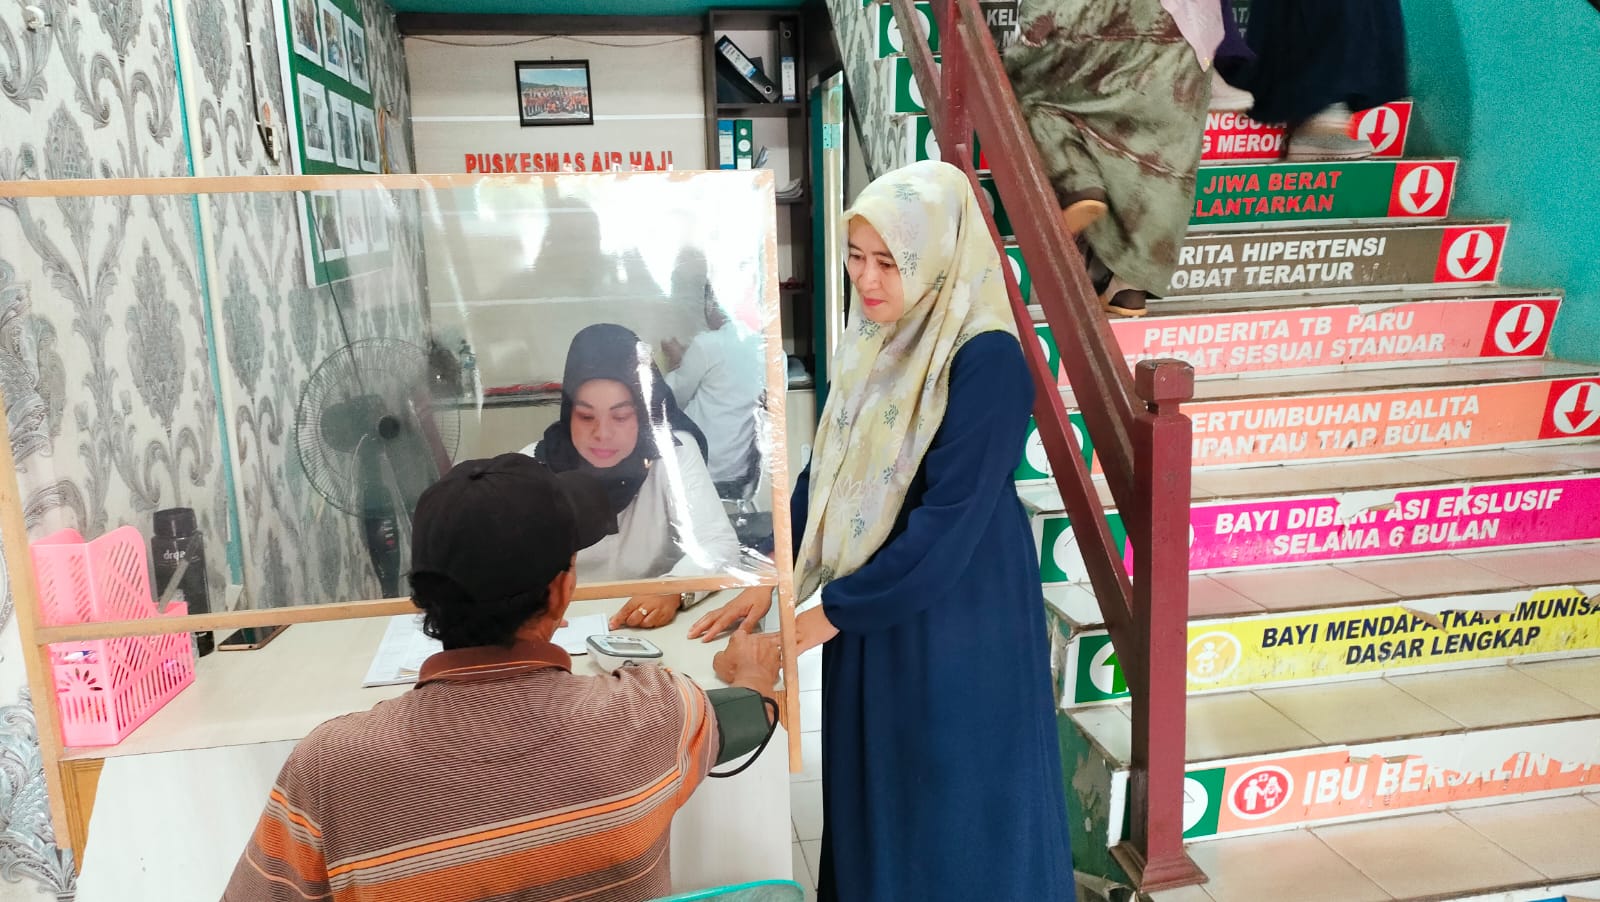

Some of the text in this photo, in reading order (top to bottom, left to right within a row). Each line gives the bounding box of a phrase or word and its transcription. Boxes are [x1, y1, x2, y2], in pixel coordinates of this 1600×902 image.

[1205, 112, 1287, 130] NGG
[464, 151, 673, 174] PUSKESMAS AIR HAJI
[1203, 171, 1342, 194] JIWA BERAT
[1192, 194, 1334, 217] LANTARKAN
[1178, 237, 1386, 266] RITA HIPERTENSI
[1166, 262, 1354, 290] OBAT TERATUR
[1144, 311, 1414, 348] PENDERITA TB PARU
[1229, 339, 1324, 366] SESUAI
[1330, 333, 1445, 359] STANDAR
[1191, 395, 1480, 433] ERTUMBUHAN BALITA
[1317, 428, 1378, 450] TIAP
[1383, 421, 1473, 445] BULAN
[1215, 508, 1279, 535] BAYI
[1384, 498, 1430, 522] ASI
[1436, 488, 1563, 519] EKSLUSIF
[1272, 518, 1499, 556] SELAMA 6 BULAN
[1261, 623, 1318, 648] BAYI
[1345, 626, 1541, 665] DASAR LENGKAP
[1303, 764, 1367, 805] IBU
